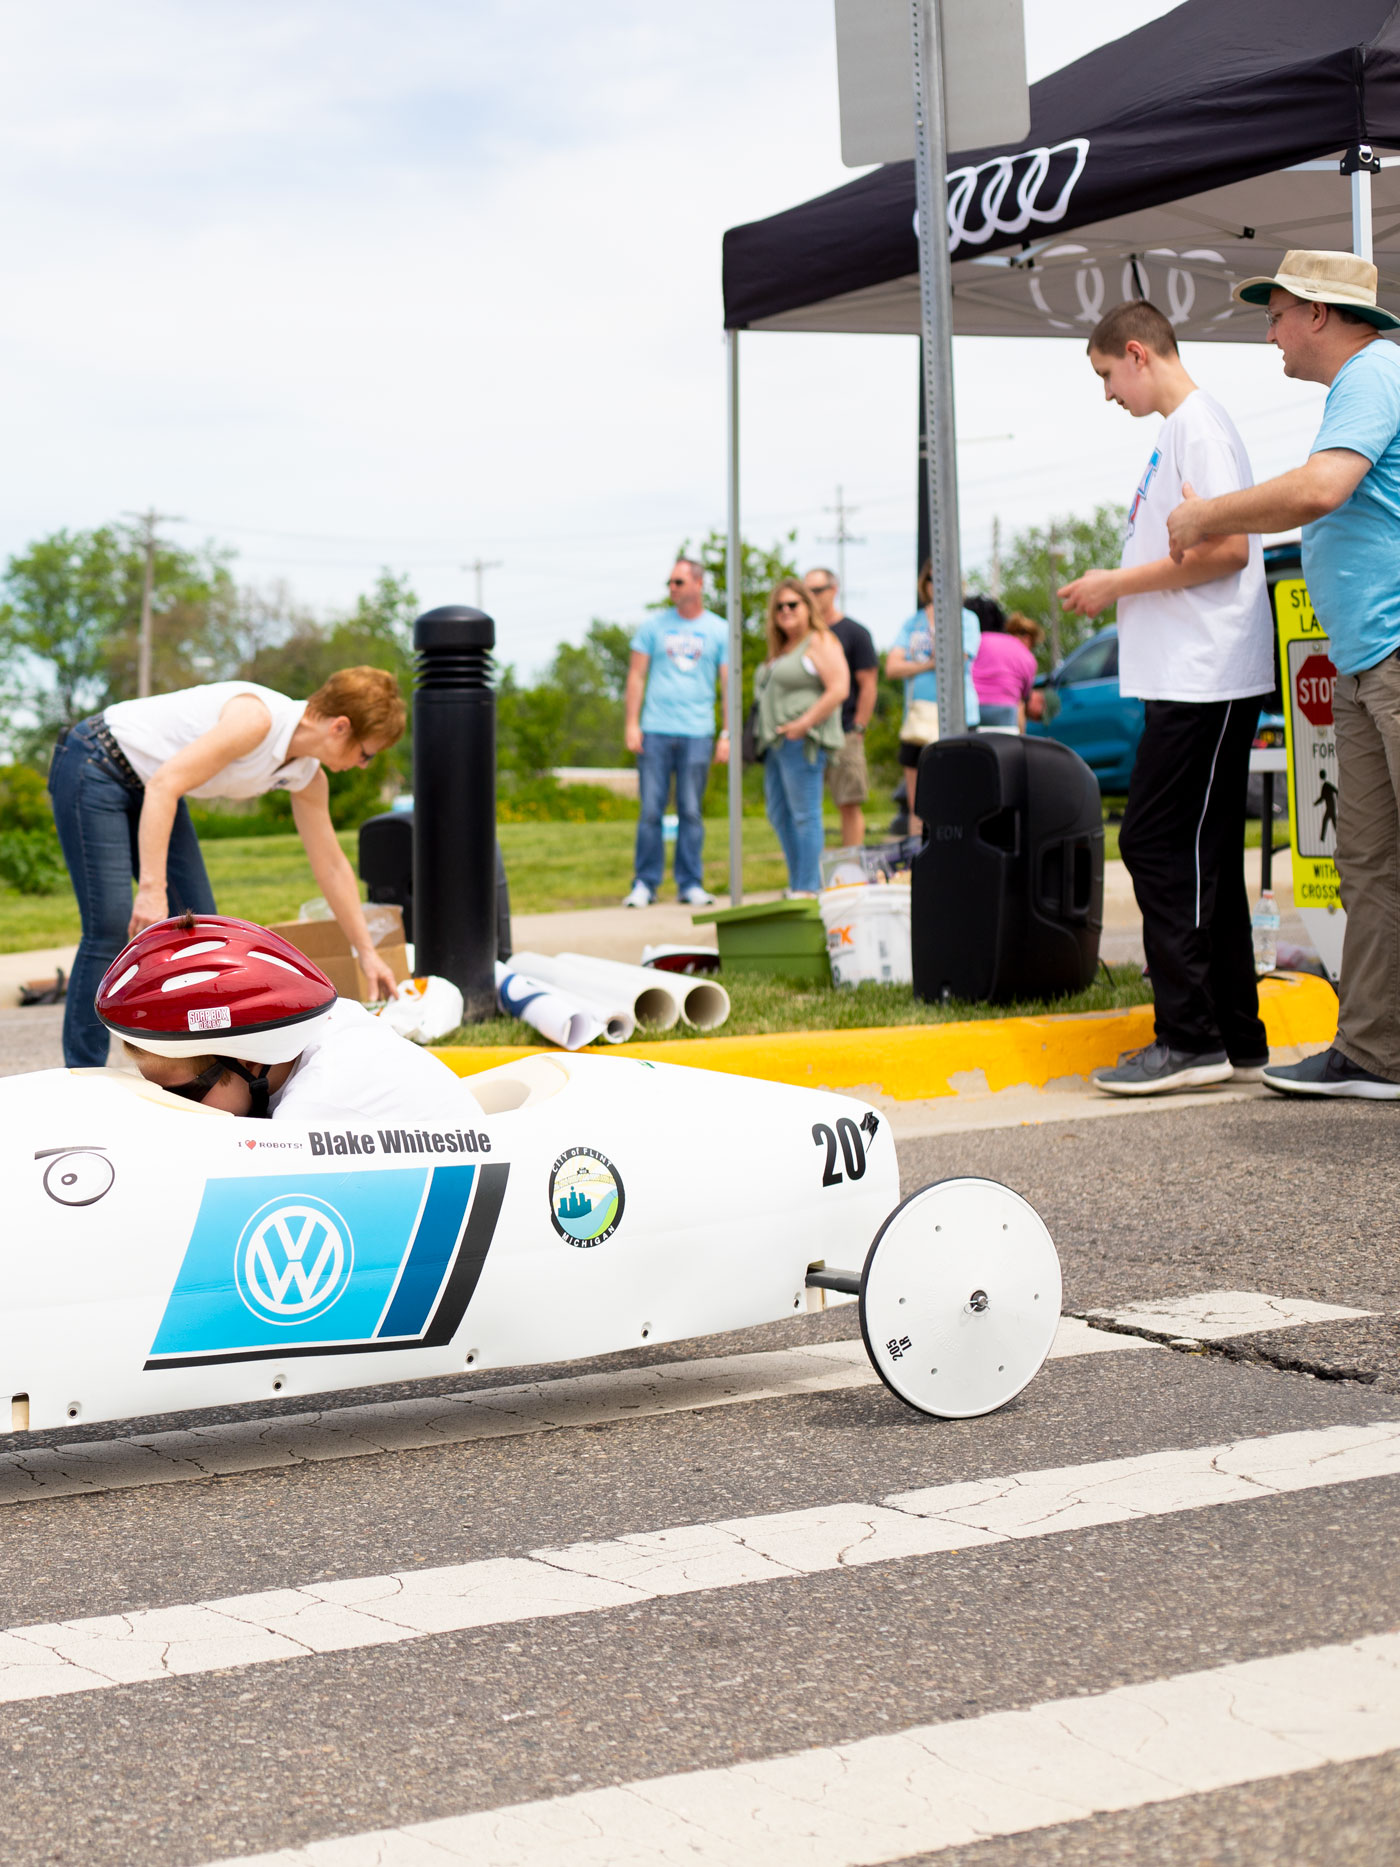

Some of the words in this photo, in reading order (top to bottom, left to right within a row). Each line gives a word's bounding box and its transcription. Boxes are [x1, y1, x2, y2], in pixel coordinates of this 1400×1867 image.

[1300, 613, 1321, 633] LA
[1312, 742, 1335, 759] FOR
[1314, 864, 1339, 879] WITH
[190, 1010, 210, 1025] SOAP
[211, 1008, 229, 1021] BOX
[199, 1019, 222, 1029] DERBY
[258, 1142, 303, 1150] ROBOTS!
[308, 1131, 376, 1156] Blake
[377, 1129, 492, 1154] Whiteside
[552, 1151, 568, 1173] CITY
[583, 1147, 612, 1168] FLINT
[561, 1225, 615, 1248] MICHIGAN
[885, 1338, 904, 1362] 205
[899, 1335, 913, 1351] LR
